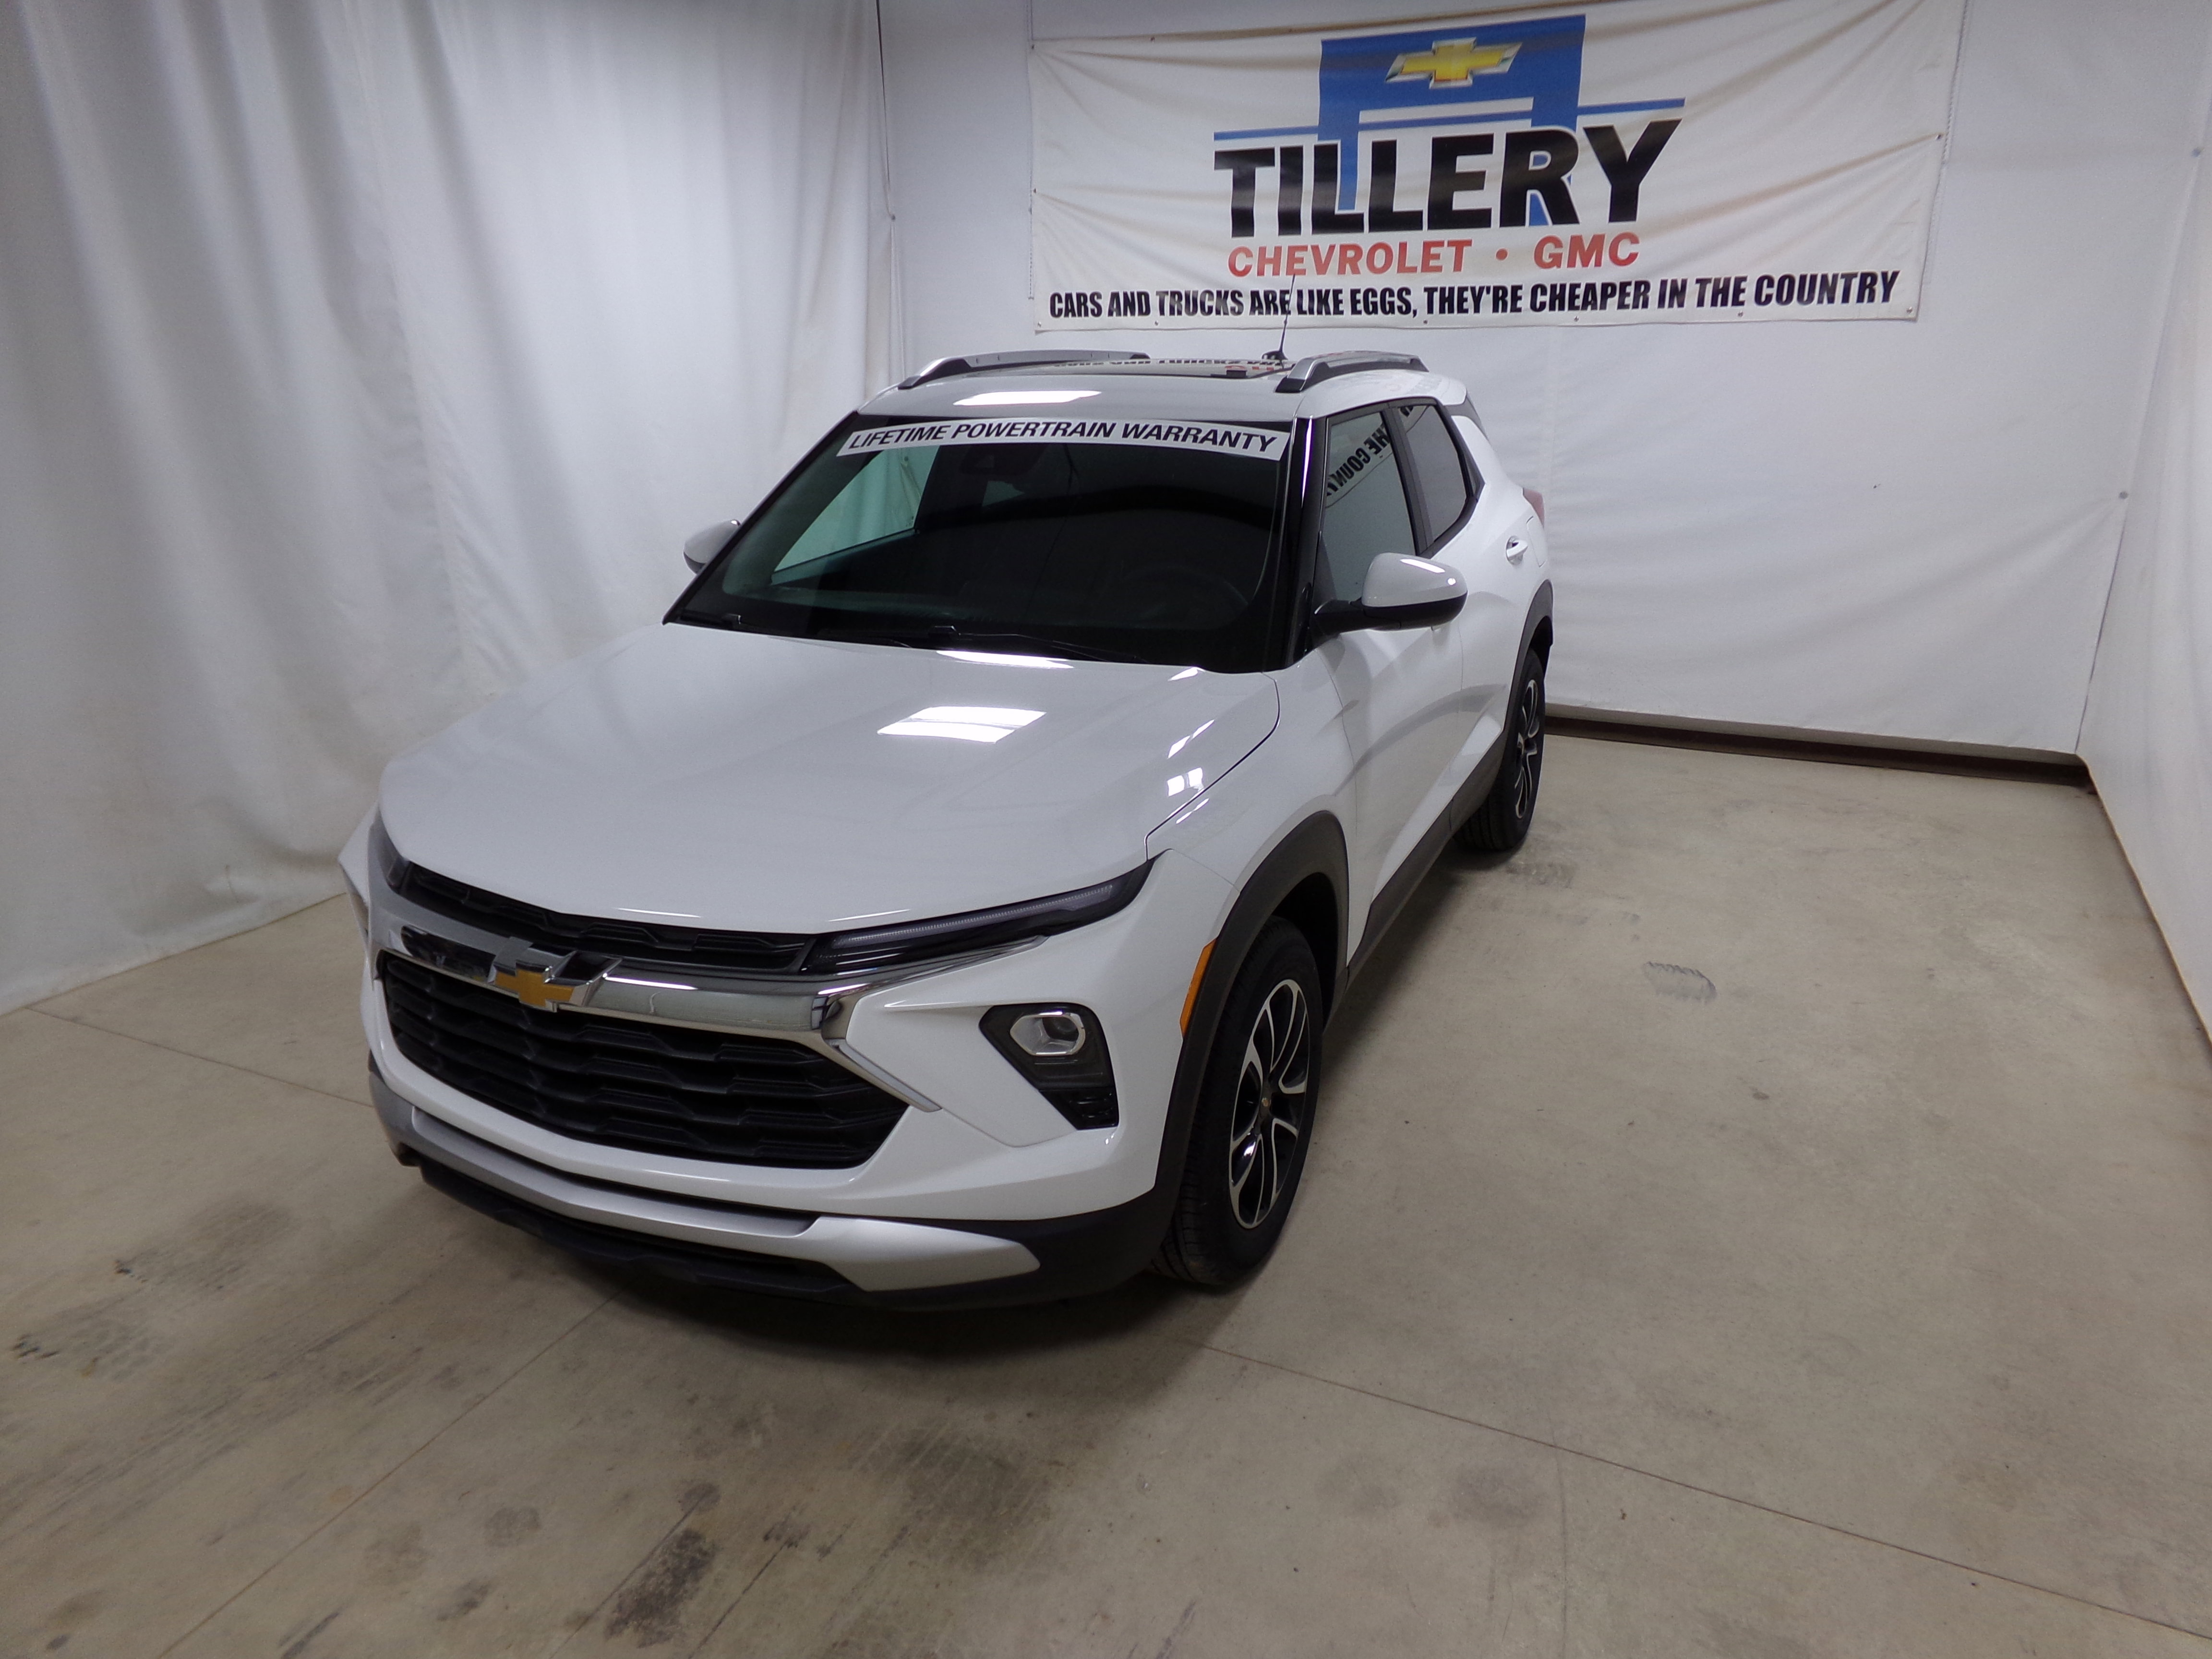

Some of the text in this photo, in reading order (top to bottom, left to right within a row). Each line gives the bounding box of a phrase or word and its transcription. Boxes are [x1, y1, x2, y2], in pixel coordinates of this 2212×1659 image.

[1214, 119, 1682, 238] TILLERY
[1227, 232, 1640, 277] CHEVROLET GMC
[1050, 270, 1900, 318] CARS AND TRUCKS ARE LIKE EGGS, THEY'RE CHEAPER IN THE COUNTRY
[848, 421, 1277, 453] LIFETIME POWERTRAIN WARRANTY
